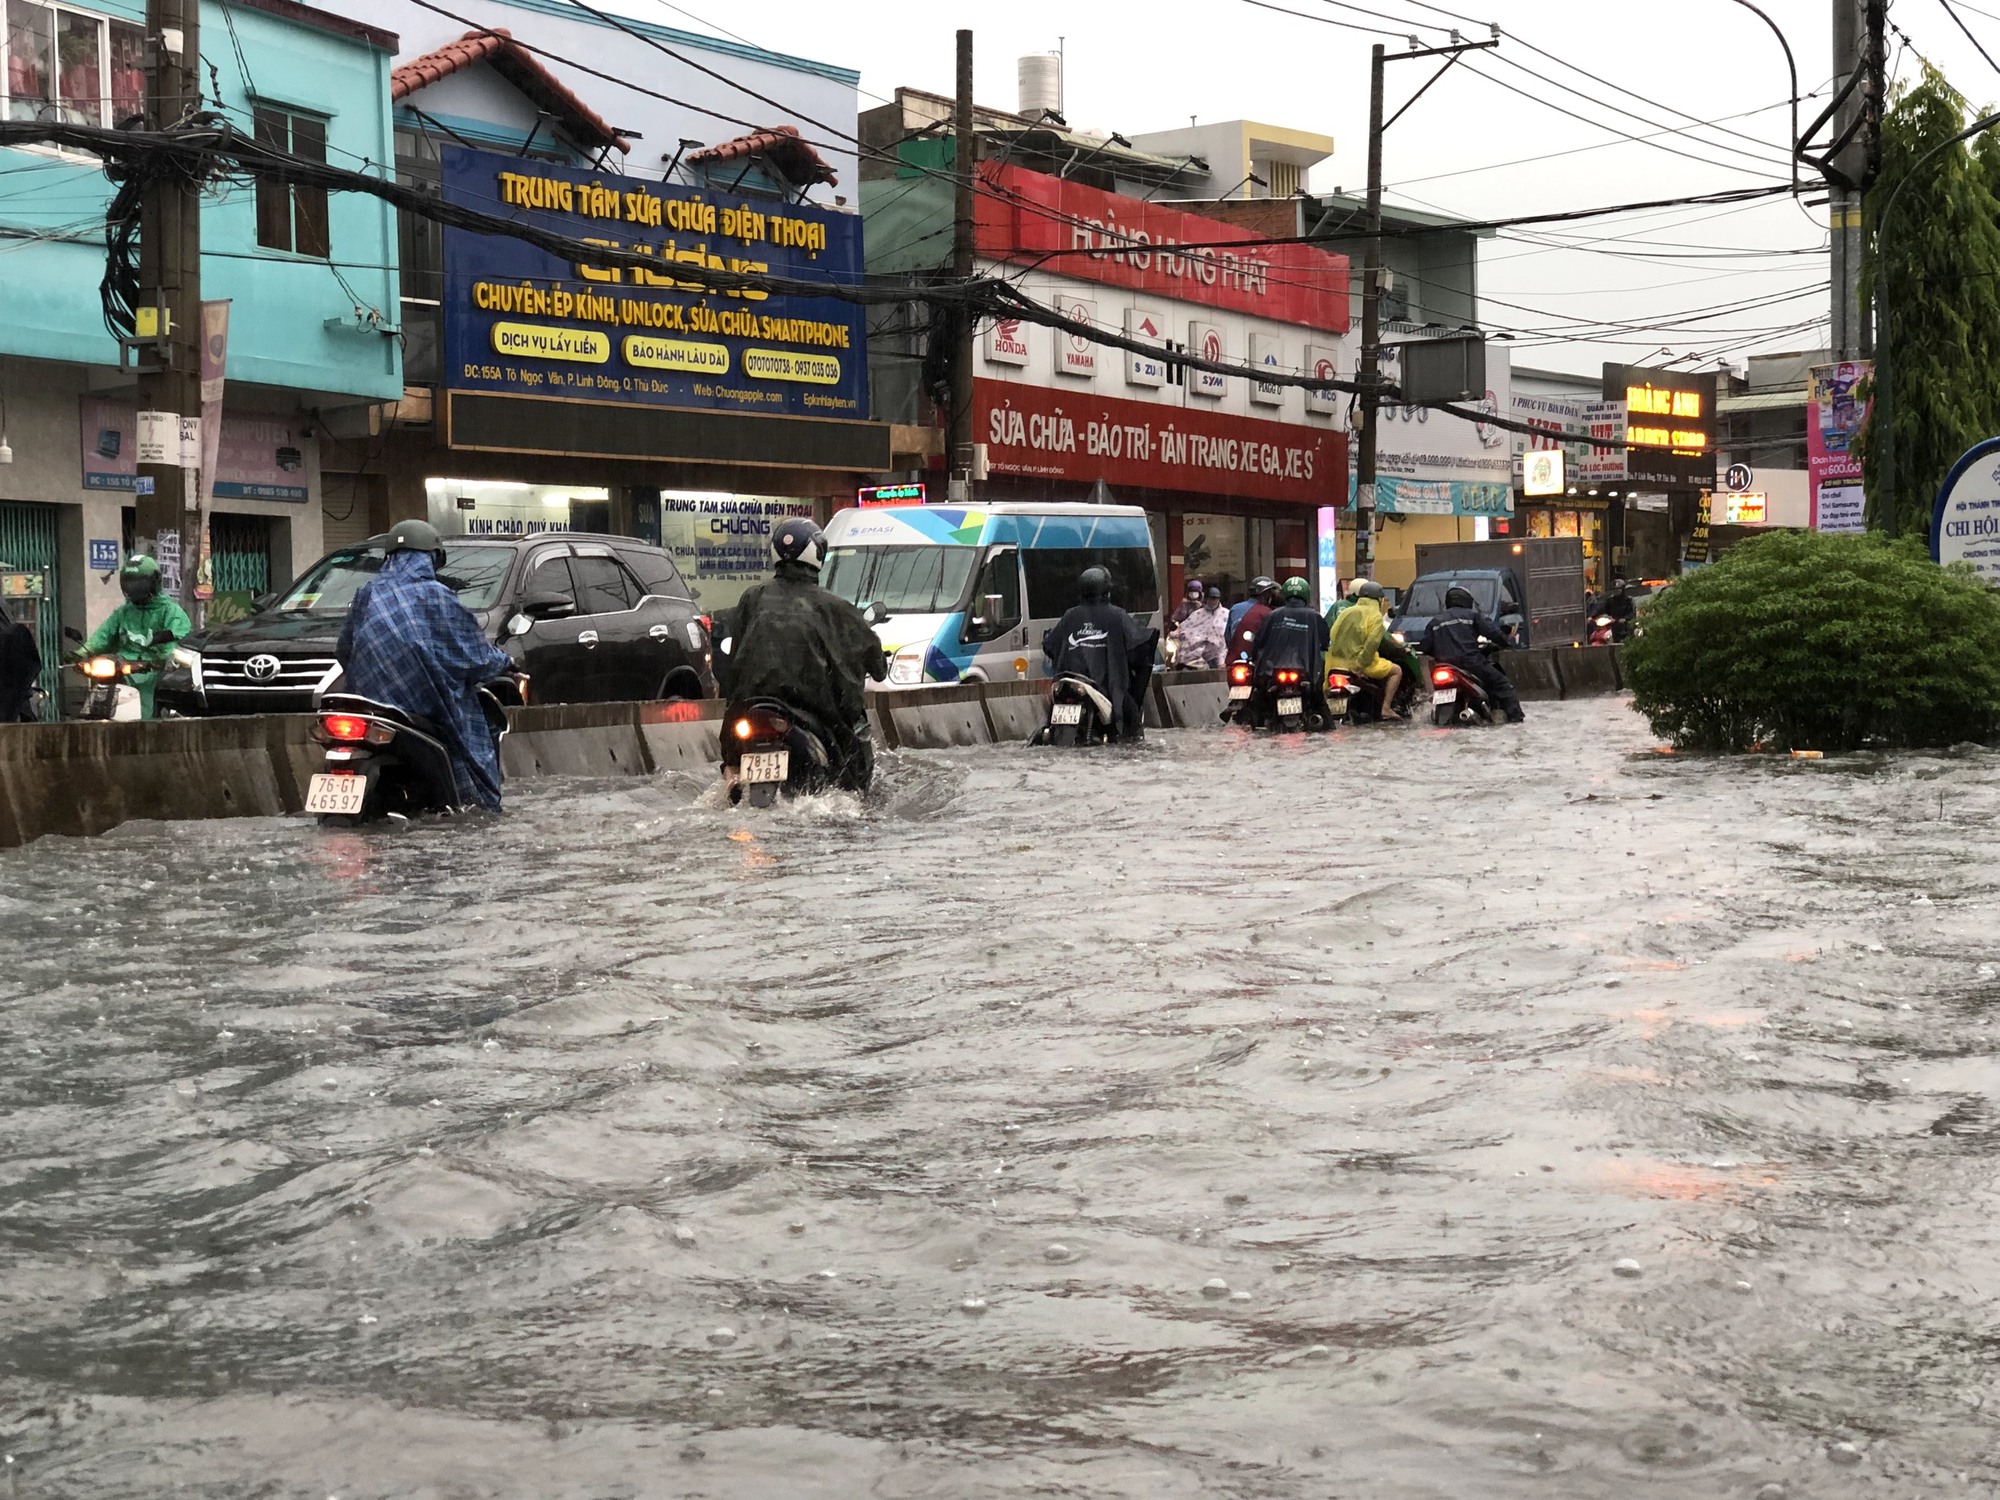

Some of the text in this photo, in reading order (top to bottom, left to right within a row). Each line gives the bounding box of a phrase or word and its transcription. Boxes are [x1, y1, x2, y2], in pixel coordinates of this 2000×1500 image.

[498, 171, 573, 212] TRUNG
[574, 180, 620, 219] TÂM
[720, 203, 766, 246] ĐIỆN
[767, 215, 826, 260] THOẠI
[1071, 208, 1151, 270] HOÀNG
[1221, 248, 1270, 296] PHÁT
[473, 280, 552, 315] CHUYÊN:
[552, 282, 573, 318] ÉP
[576, 287, 619, 327] KÍNH,
[621, 298, 689, 334] UNLOCK,
[759, 315, 850, 349] SMARTPHONE
[501, 332, 529, 350] DỊCH
[532, 336, 547, 353] VỤ
[550, 331, 571, 353] LẤY
[995, 339, 1028, 356] HONDA
[633, 341, 726, 367] BẢO HÀNH LÂU DÀI
[1066, 352, 1094, 368] YAMAHA
[795, 359, 810, 376] 0937
[506, 367, 517, 381] Tô
[520, 369, 543, 387] Ngọc
[576, 373, 593, 388] Linh
[1202, 375, 1223, 387] SYM
[989, 398, 1027, 448] SỬA
[1029, 407, 1076, 453] CHỮA
[1087, 412, 1123, 459] BẢO
[1159, 423, 1187, 465] TÂN
[1189, 434, 1238, 471] TRANG
[1239, 440, 1259, 473] XE
[1260, 443, 1283, 482] GA,
[1284, 447, 1303, 479] XE
[664, 498, 697, 513] TRUNG
[764, 499, 786, 518] ĐIỆN
[1832, 501, 1859, 509] Samsung
[469, 515, 493, 534] KÍNH
[496, 516, 523, 534] CHÀO
[710, 515, 771, 535] CHƯƠNG
[861, 526, 894, 534] EMASI
[1946, 515, 1999, 538] CHI HỘI
[91, 543, 118, 560] 155
[749, 560, 770, 571] APPLE
[747, 767, 781, 781] 0783
[318, 777, 356, 794] 76-G1
[310, 794, 360, 810] 465.97
